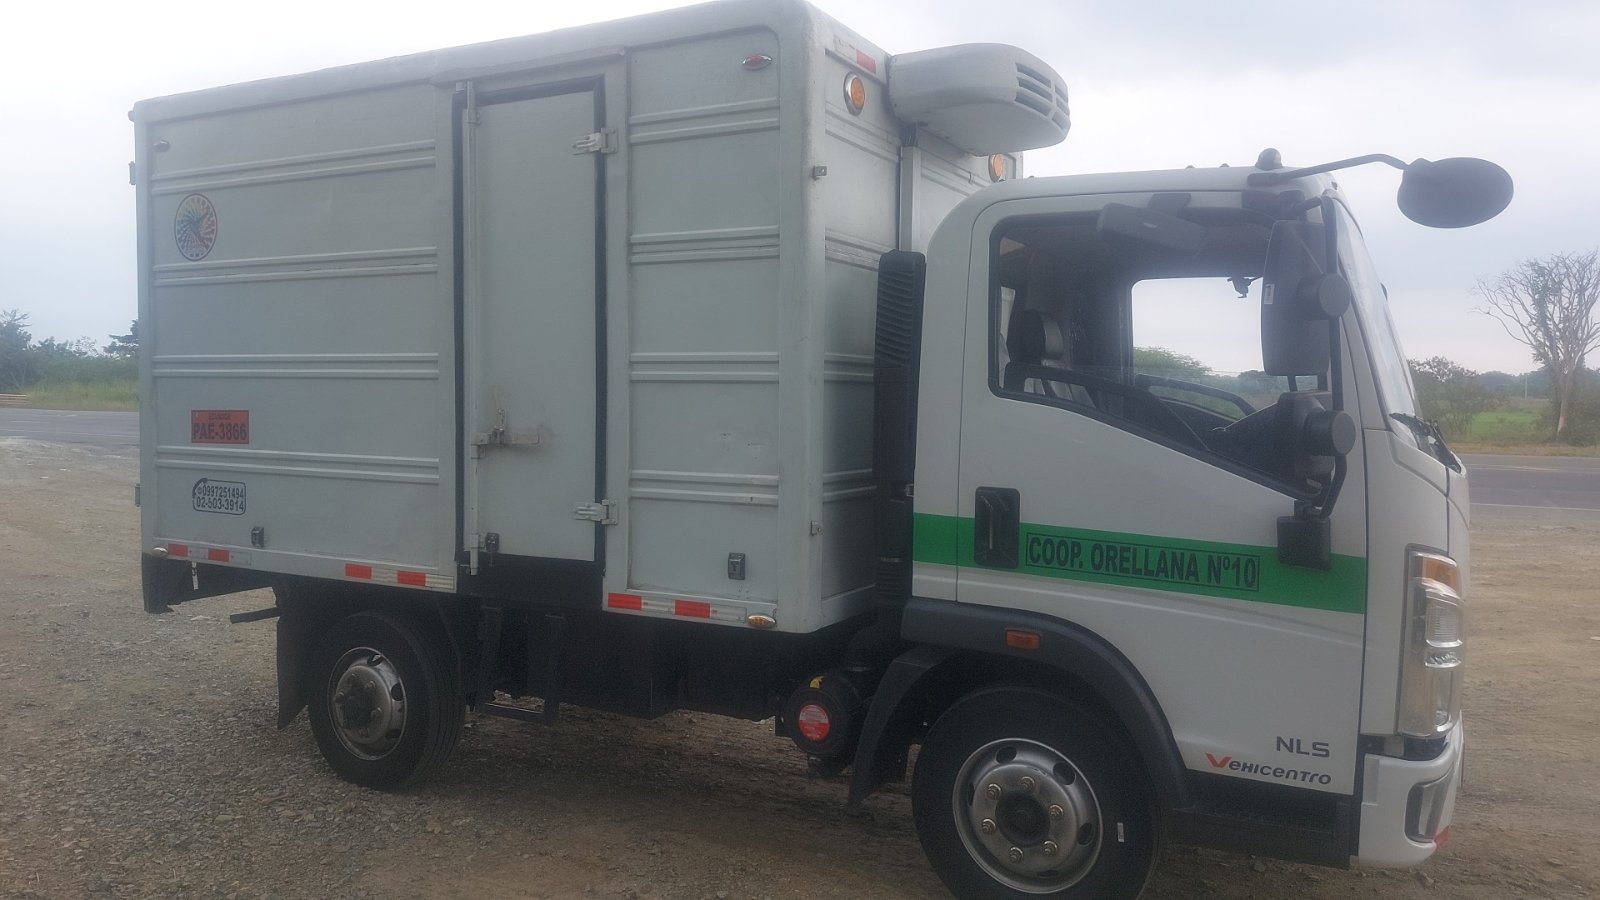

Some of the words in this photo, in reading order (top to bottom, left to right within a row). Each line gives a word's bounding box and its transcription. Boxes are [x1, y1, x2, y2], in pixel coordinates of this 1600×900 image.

[193, 422, 247, 441] PAE-3866
[203, 484, 244, 500] 0997251494
[196, 496, 245, 512] 02-503-3914
[1029, 536, 1084, 569] COOP.
[1090, 543, 1200, 582] ORELLANA
[1276, 735, 1330, 758] NLS
